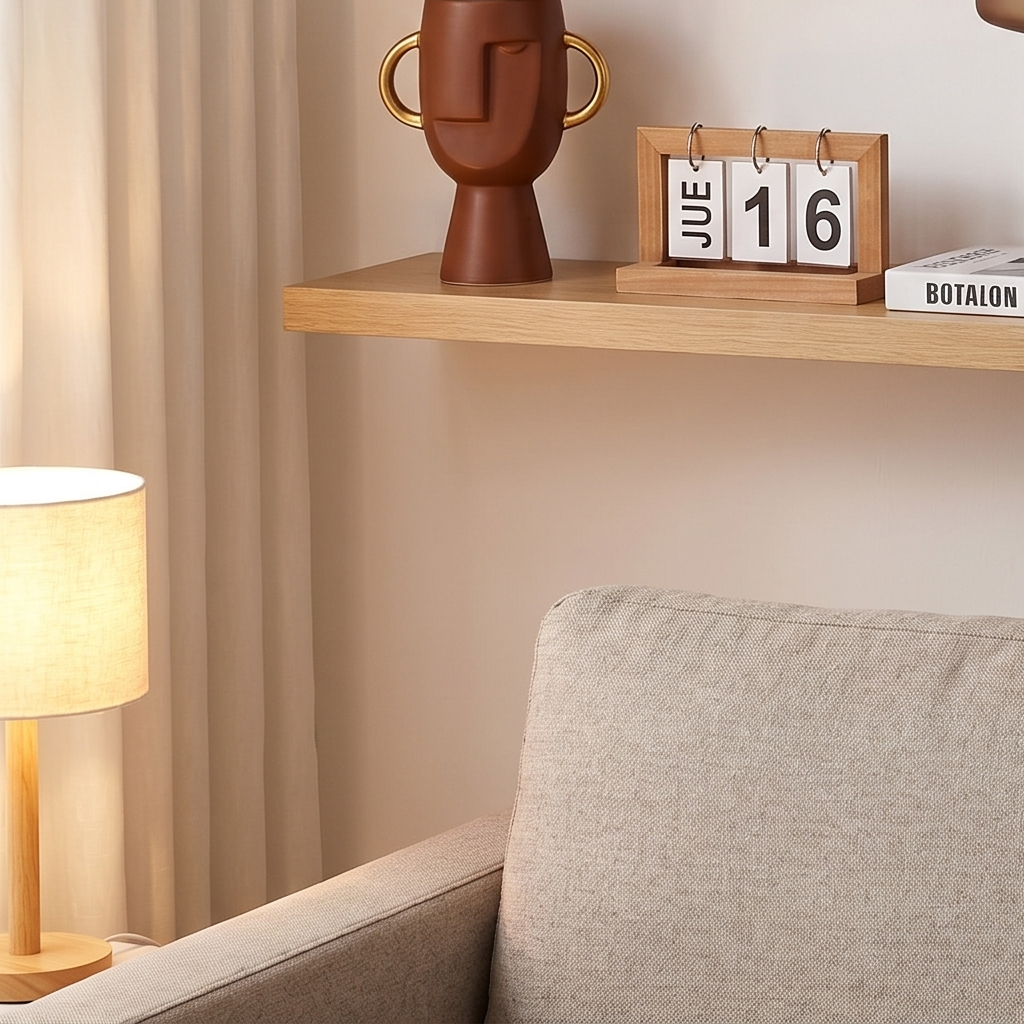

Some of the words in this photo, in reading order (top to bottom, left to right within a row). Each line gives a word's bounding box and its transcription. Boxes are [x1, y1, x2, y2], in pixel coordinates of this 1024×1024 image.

[681, 181, 712, 249] JUE
[744, 186, 770, 248] 1
[805, 188, 842, 251] 6
[926, 282, 1018, 308] BOTALON
